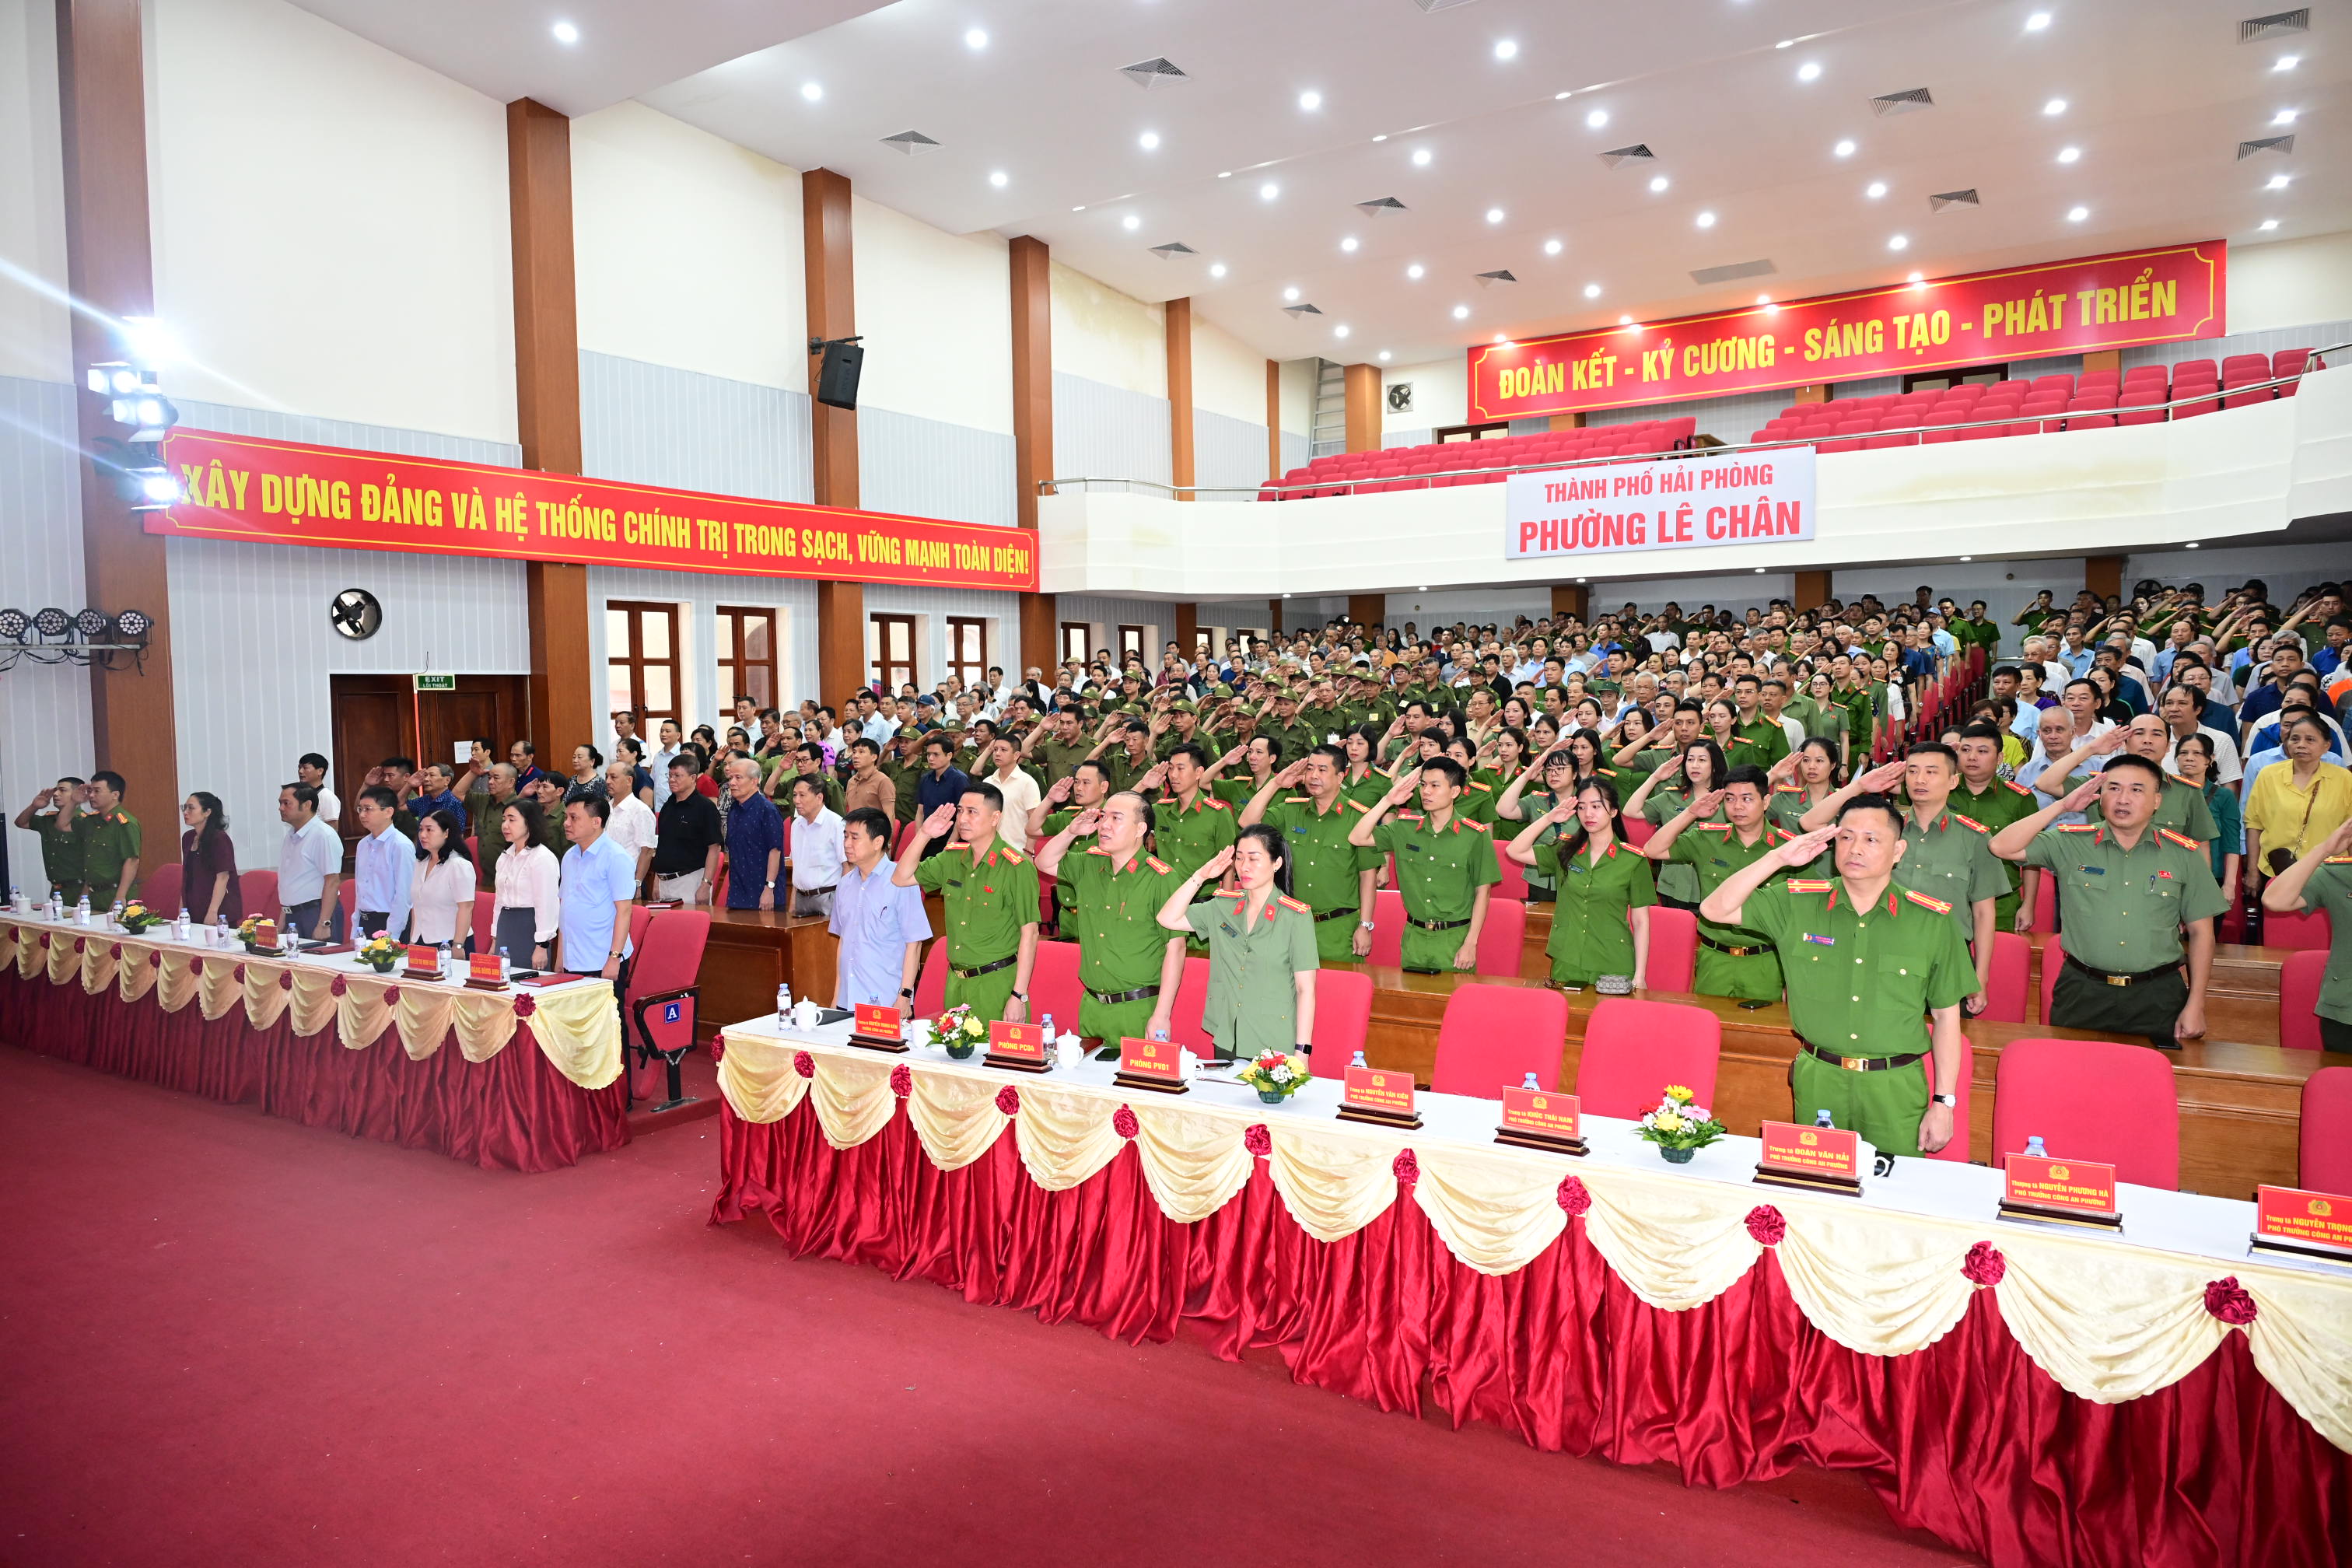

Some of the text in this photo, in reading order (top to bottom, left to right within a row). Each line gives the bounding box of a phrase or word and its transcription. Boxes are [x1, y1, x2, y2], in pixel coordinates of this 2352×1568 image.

[1499, 358, 1564, 399] ĐOÀN
[1573, 348, 1617, 388] KẾT
[1643, 339, 1675, 383] KỶ
[1683, 334, 1775, 376] CƯƠNG
[1784, 345, 1795, 355] -
[1804, 318, 1884, 362] SÁNG
[1893, 310, 1951, 355] TẠO
[1961, 322, 1972, 331] -
[1984, 290, 2067, 338] PHÁT
[2077, 268, 2176, 326] TRIỂN
[1545, 461, 1773, 503] THÀNH PHỐ HẢI PHÒNG
[180, 460, 1028, 579] XÂY DỰNG ĐẢNG VÀ HỆ THỐNG CHÍNH TRỊ TRONG SẠCH, VỮNG MẠNH TOÀN DIỆN!
[1519, 495, 1801, 553] PHƯỜNG LÊ CHÂN
[667, 1007, 677, 1019] A
[998, 1041, 1034, 1052] PHÒNG PC04
[1129, 1059, 1169, 1071] PHÒNG PV01
[2039, 1182, 2067, 1192] NGUYỄN
[2068, 1185, 2097, 1196] PHƯƠNG
[2266, 1215, 2284, 1223] Trung
[2293, 1217, 2325, 1229] NGUYỄN
[2327, 1222, 2352, 1233] TRỌNG
[2283, 1227, 2309, 1236] TRƯỞNG
[2312, 1230, 2330, 1239] CÔNG
